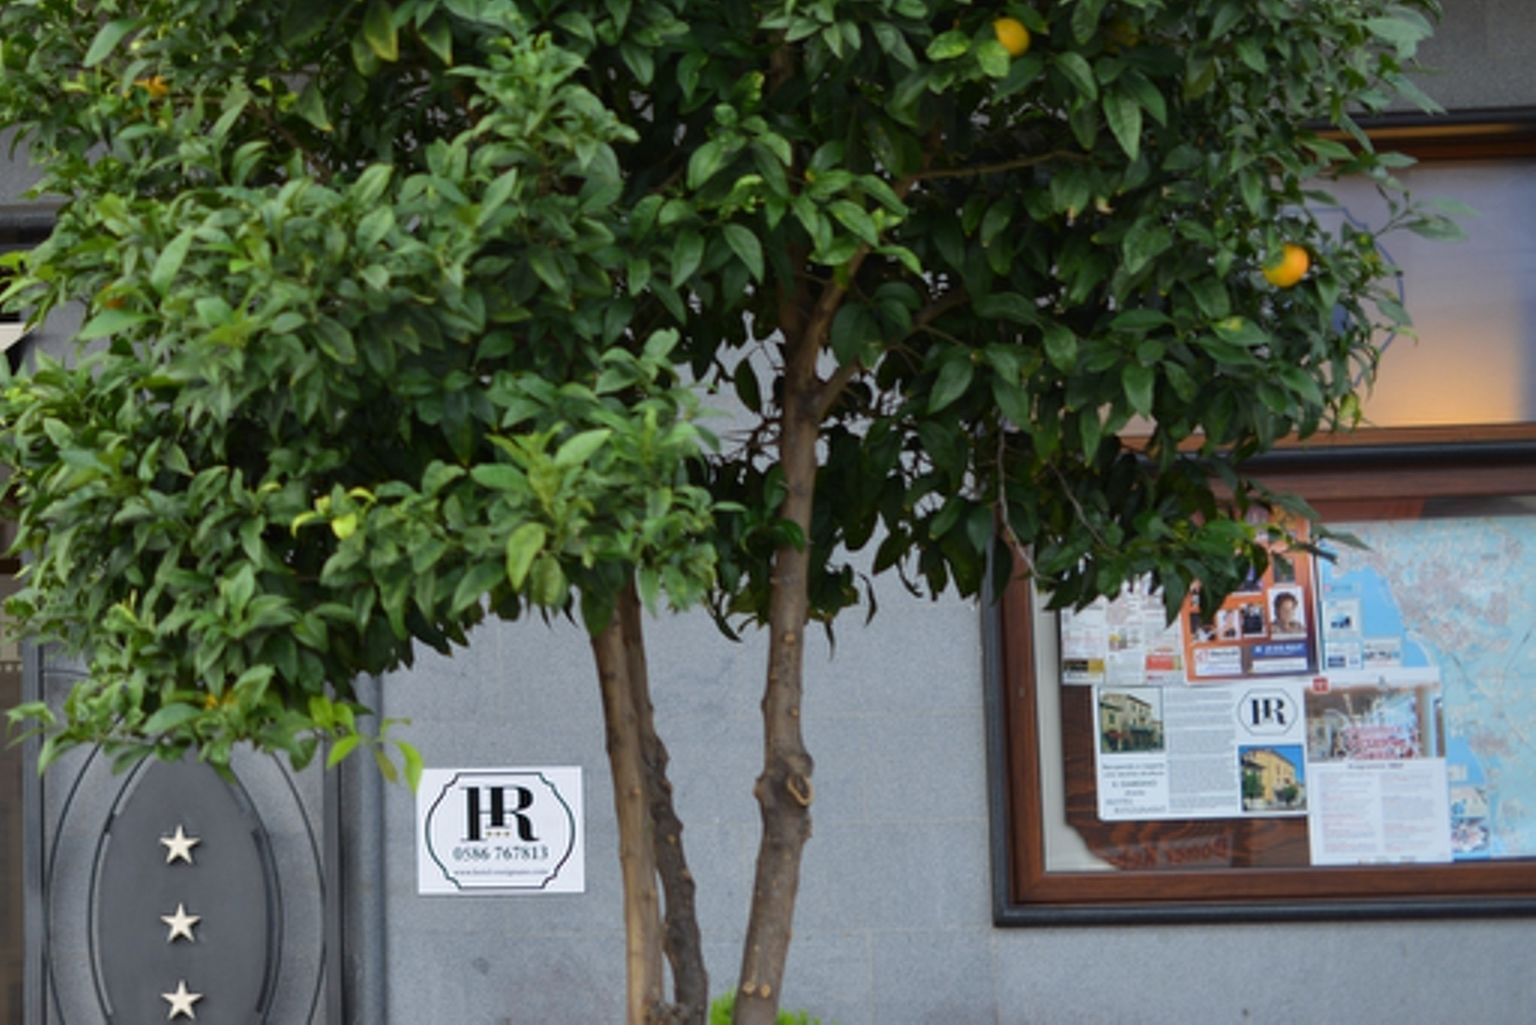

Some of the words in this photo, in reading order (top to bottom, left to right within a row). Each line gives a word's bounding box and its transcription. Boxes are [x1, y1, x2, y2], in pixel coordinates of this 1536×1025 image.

[459, 785, 540, 842] HR
[452, 846, 491, 862] 0586
[494, 846, 549, 862] 767813
